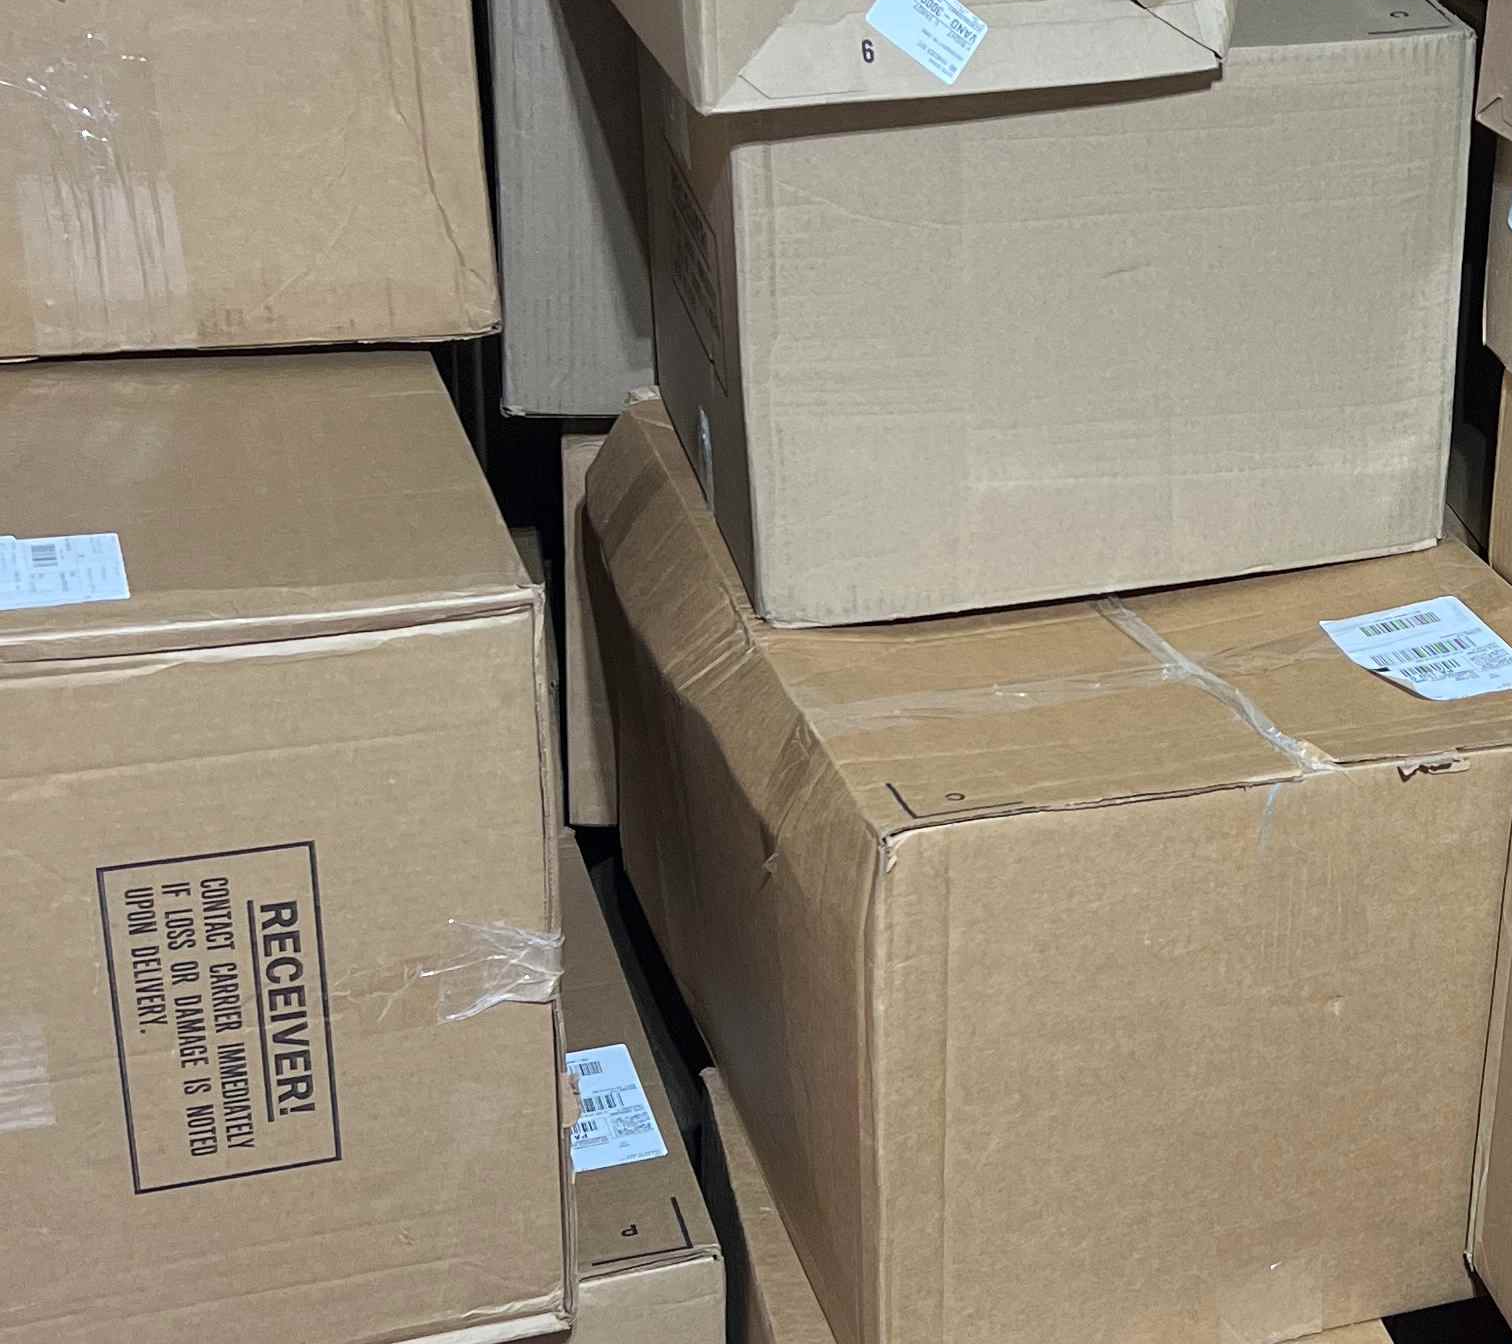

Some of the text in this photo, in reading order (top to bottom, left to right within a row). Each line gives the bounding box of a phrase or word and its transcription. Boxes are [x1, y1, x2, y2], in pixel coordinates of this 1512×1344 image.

[124, 887, 168, 1034] UPON DELIVERY.
[161, 881, 218, 1157] IF LOSS OR DAMAGE IS NOTED
[200, 877, 255, 1150] CONTACT CARRIER IMMEDIATELY
[260, 901, 316, 1116] RECEIVER!
